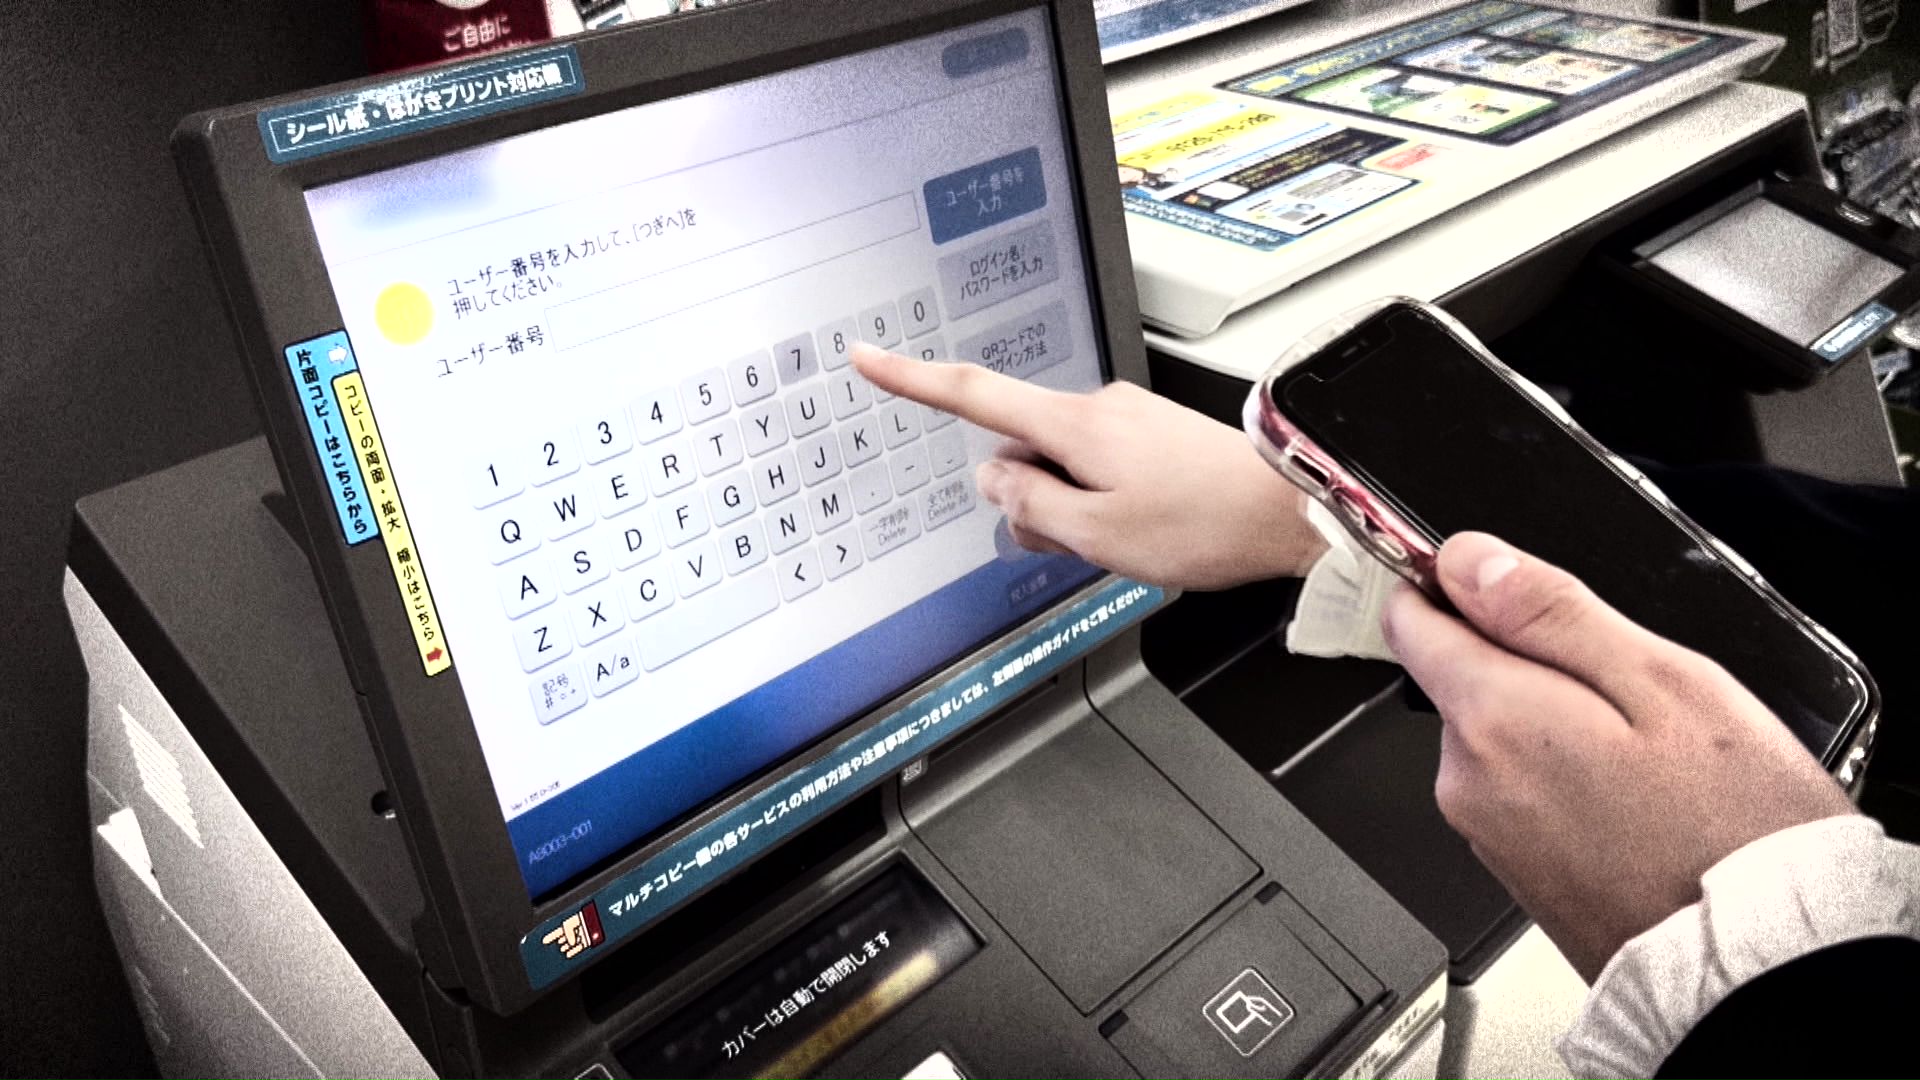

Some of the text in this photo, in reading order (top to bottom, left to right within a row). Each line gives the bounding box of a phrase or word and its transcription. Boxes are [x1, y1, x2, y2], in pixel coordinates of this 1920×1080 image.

[443, 13, 512, 53] ご自由に
[977, 193, 1002, 218] 入力
[452, 274, 563, 321] 押してください。
[960, 255, 1043, 301] パスワードを入力
[437, 324, 545, 378] ユーザー番号
[488, 300, 926, 487] 1 2 3 4 5 6 7 8 9 0
[295, 348, 369, 535] 片面コピーはこちらから
[500, 519, 522, 544] Q
[553, 494, 576, 522] W
[610, 475, 629, 500] E
[661, 454, 680, 479] R
[710, 433, 723, 457] T
[755, 415, 769, 438] Y
[800, 397, 816, 421] U
[520, 413, 908, 601] A S D F G H J K L
[533, 626, 553, 653] Z
[587, 601, 607, 628] X
[639, 578, 657, 602] C
[687, 555, 703, 578] V
[735, 535, 752, 559] B
[779, 513, 796, 537] N
[821, 493, 840, 518] M
[595, 652, 631, 684] A/a
[720, 928, 894, 1060] カバーは自動で開閉します
